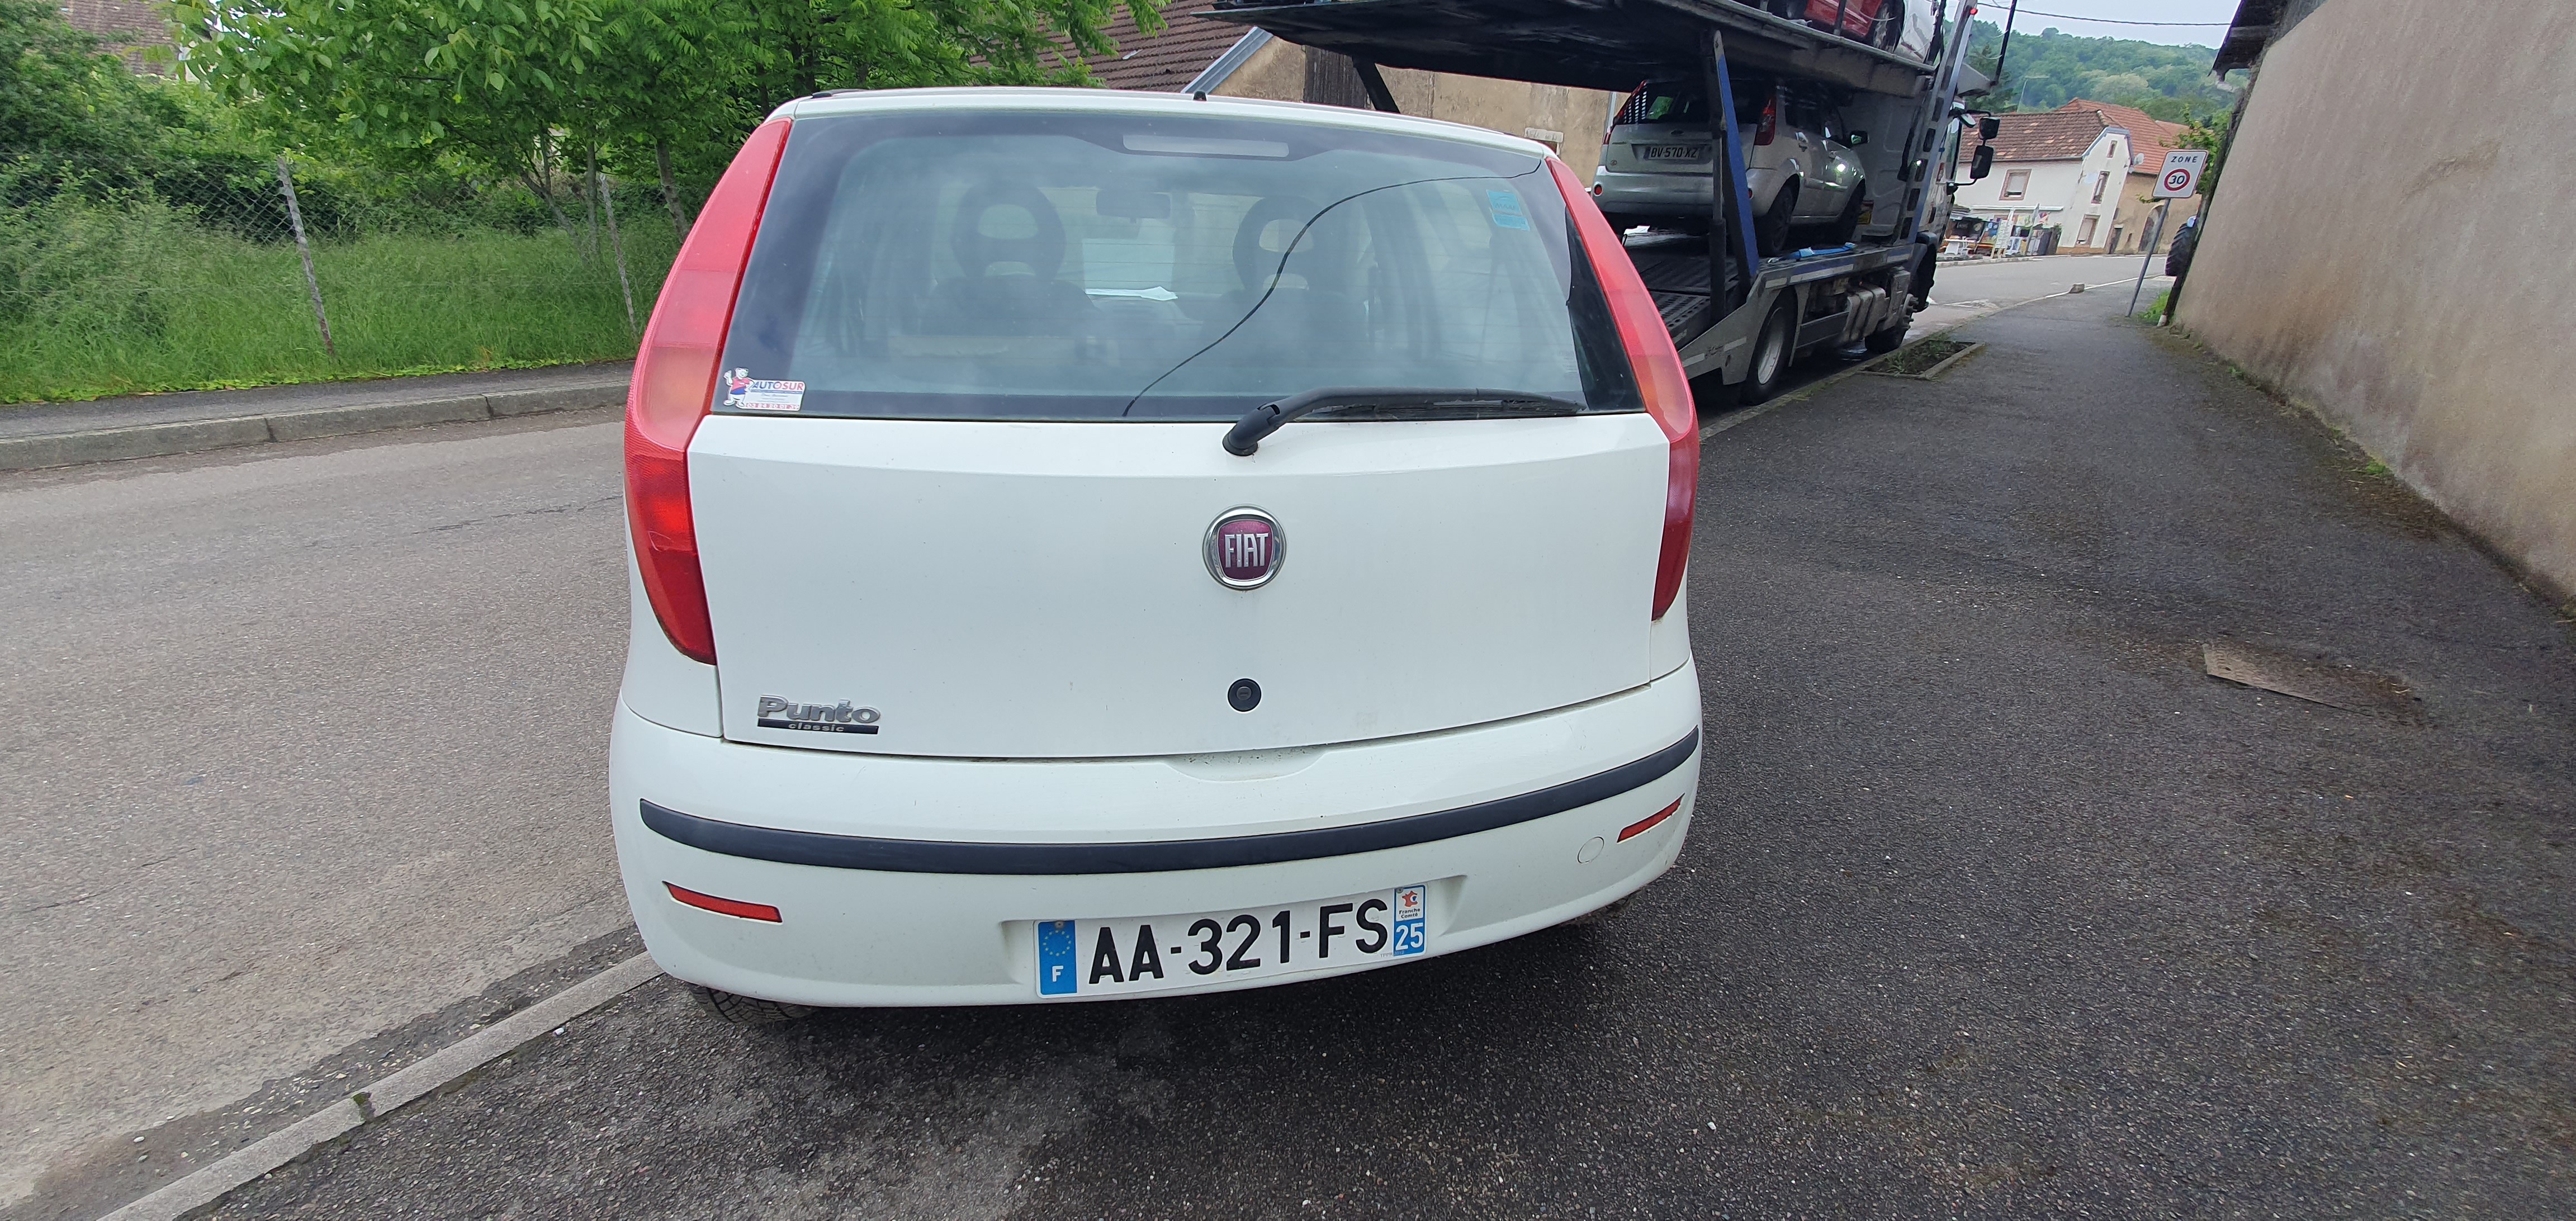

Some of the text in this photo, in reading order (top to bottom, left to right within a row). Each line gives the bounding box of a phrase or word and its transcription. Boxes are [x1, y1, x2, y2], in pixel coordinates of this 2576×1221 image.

[2169, 175, 2185, 184] 30
[752, 381, 804, 391] AUTOSUR
[1225, 533, 1269, 568] FIAT
[757, 694, 880, 723] Punto
[788, 722, 845, 732] classic
[1052, 898, 1388, 985] F AA-321-FS
[1395, 922, 1424, 951] 25
